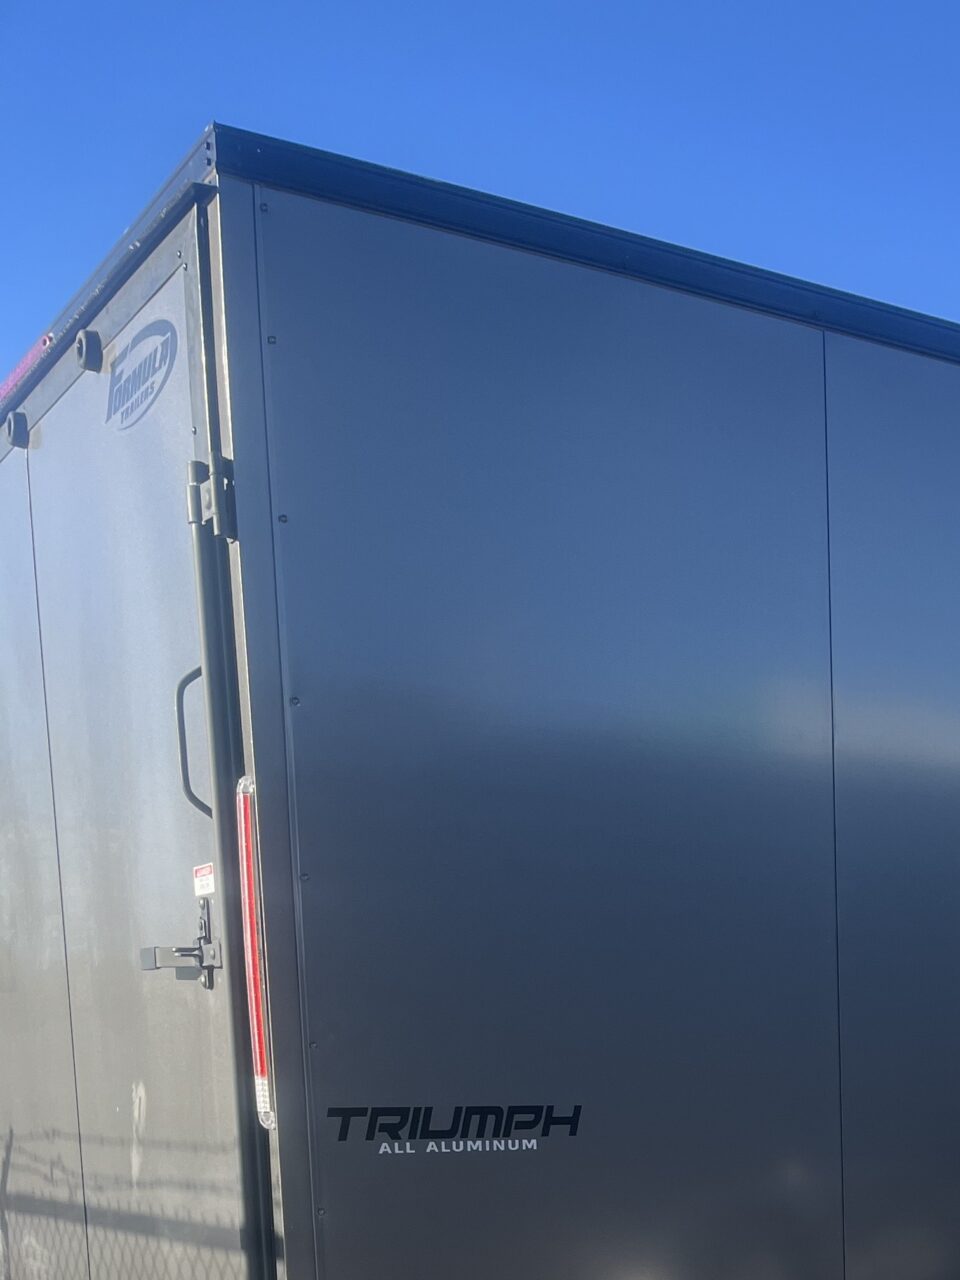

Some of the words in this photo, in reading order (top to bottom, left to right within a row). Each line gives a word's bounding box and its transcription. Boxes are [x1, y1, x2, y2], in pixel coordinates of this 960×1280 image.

[105, 336, 171, 424] FORMULA
[121, 380, 155, 424] TRAILERS
[327, 1105, 582, 1141] TRIUMPH
[378, 1142, 416, 1154] ALL
[426, 1139, 538, 1152] ALUMINUM
